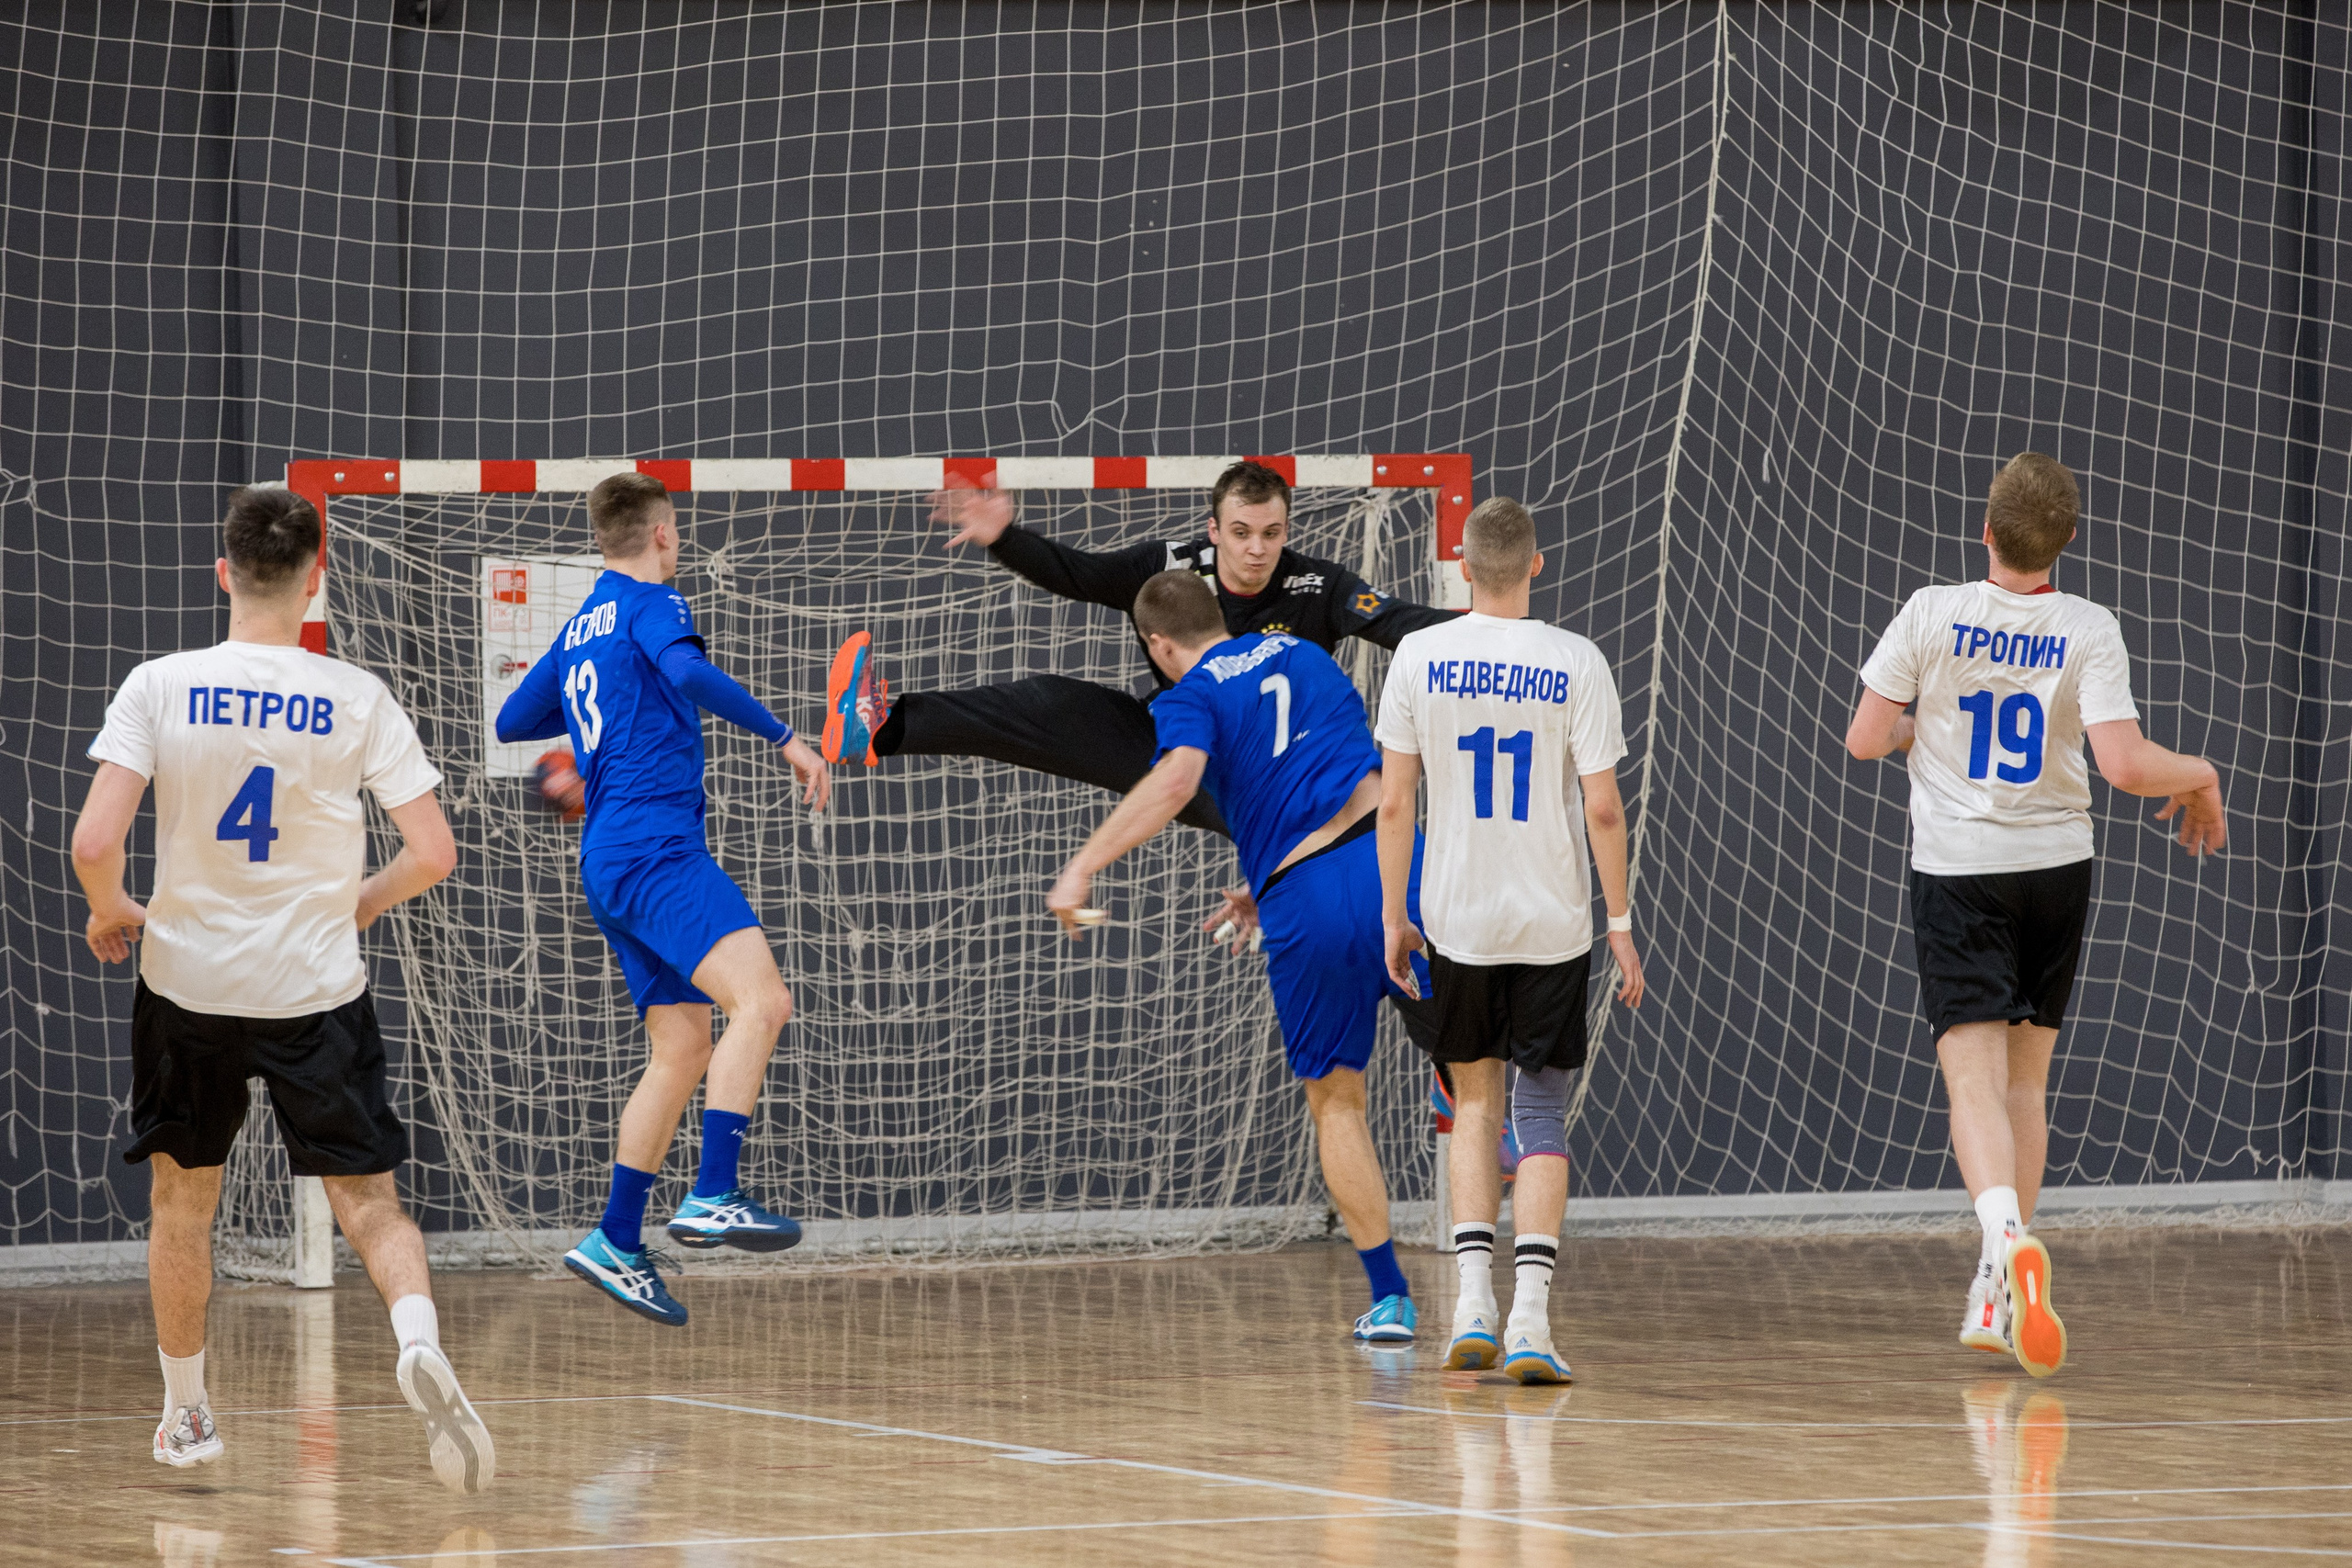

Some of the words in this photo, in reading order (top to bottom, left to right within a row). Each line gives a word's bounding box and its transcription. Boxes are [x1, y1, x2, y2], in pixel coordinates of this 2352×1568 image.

[1428, 660, 1568, 705] МЕДВЕДКОВ
[1951, 623, 2067, 670] ТРОПИН
[189, 687, 334, 736] ПЕТРОВ
[563, 659, 603, 754] 13
[1959, 689, 2044, 784] 19
[216, 765, 279, 863] 4
[1457, 726, 1533, 822] 11
